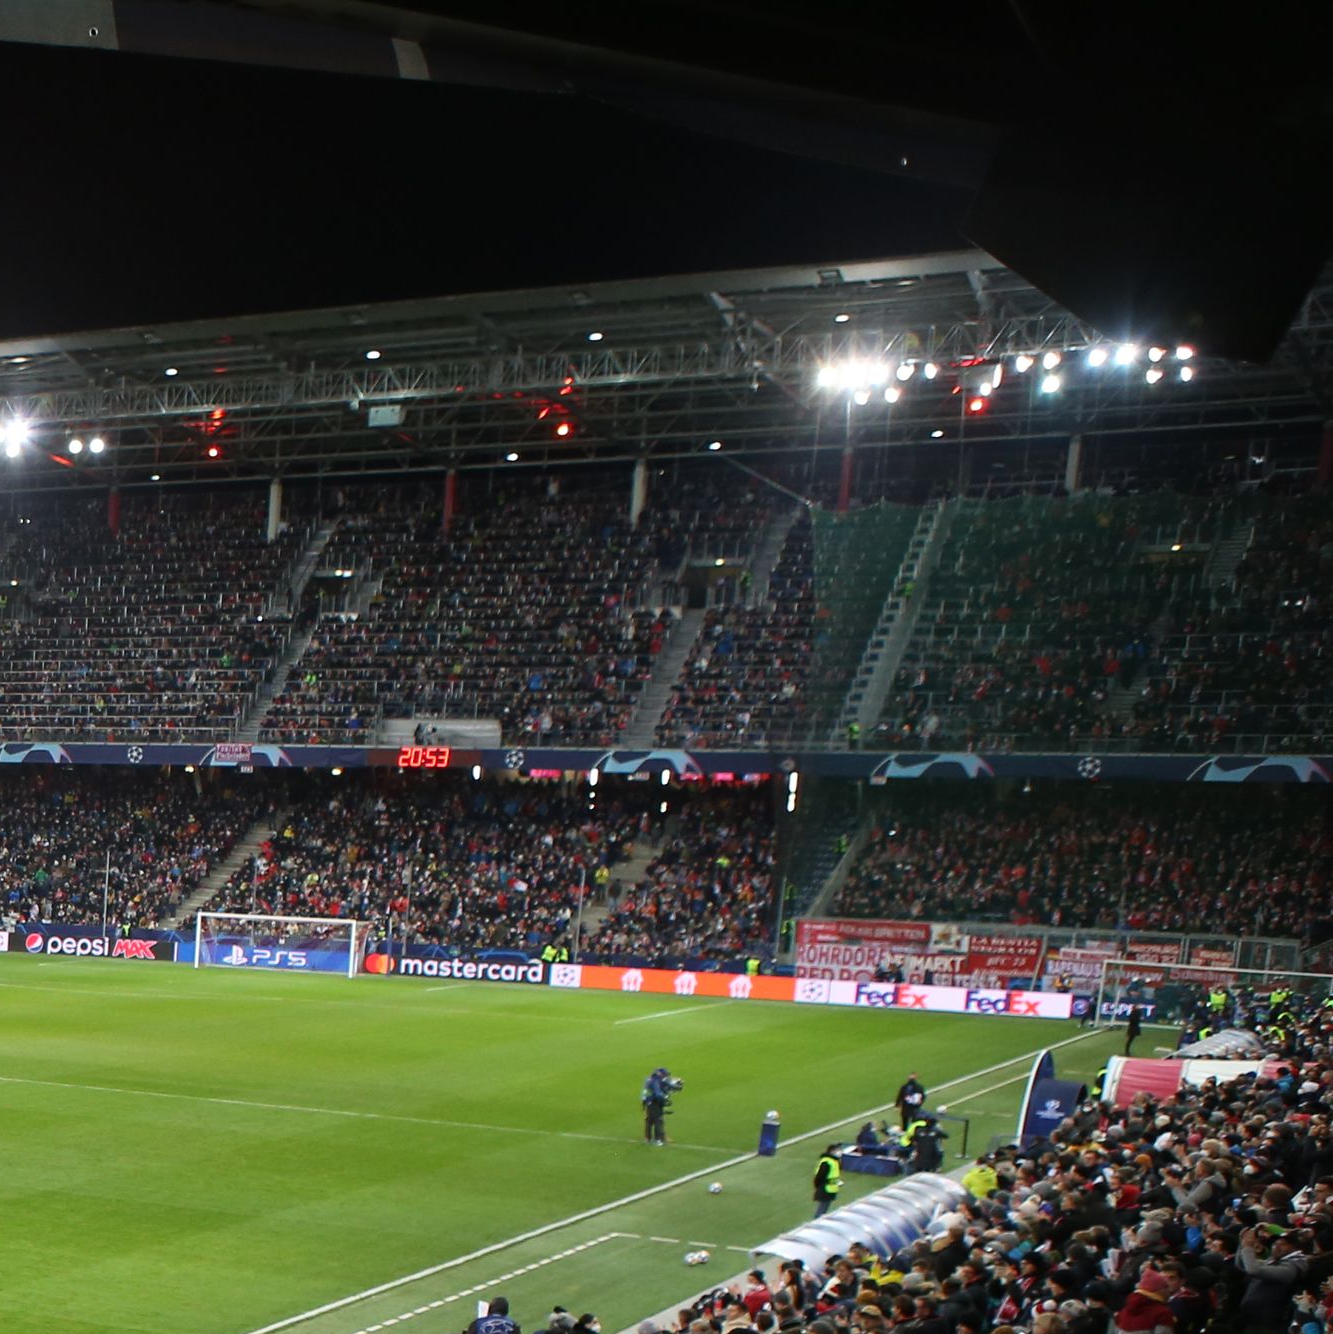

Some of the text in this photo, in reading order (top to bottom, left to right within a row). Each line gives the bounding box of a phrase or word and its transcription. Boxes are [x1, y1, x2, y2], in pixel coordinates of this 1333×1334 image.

[398, 746, 450, 768] 20:53
[46, 935, 158, 960] pepsi MAX
[251, 947, 308, 968] PS5
[399, 957, 544, 984] mastercard
[855, 982, 930, 1009] FedEx
[965, 989, 1042, 1017] FedEx
